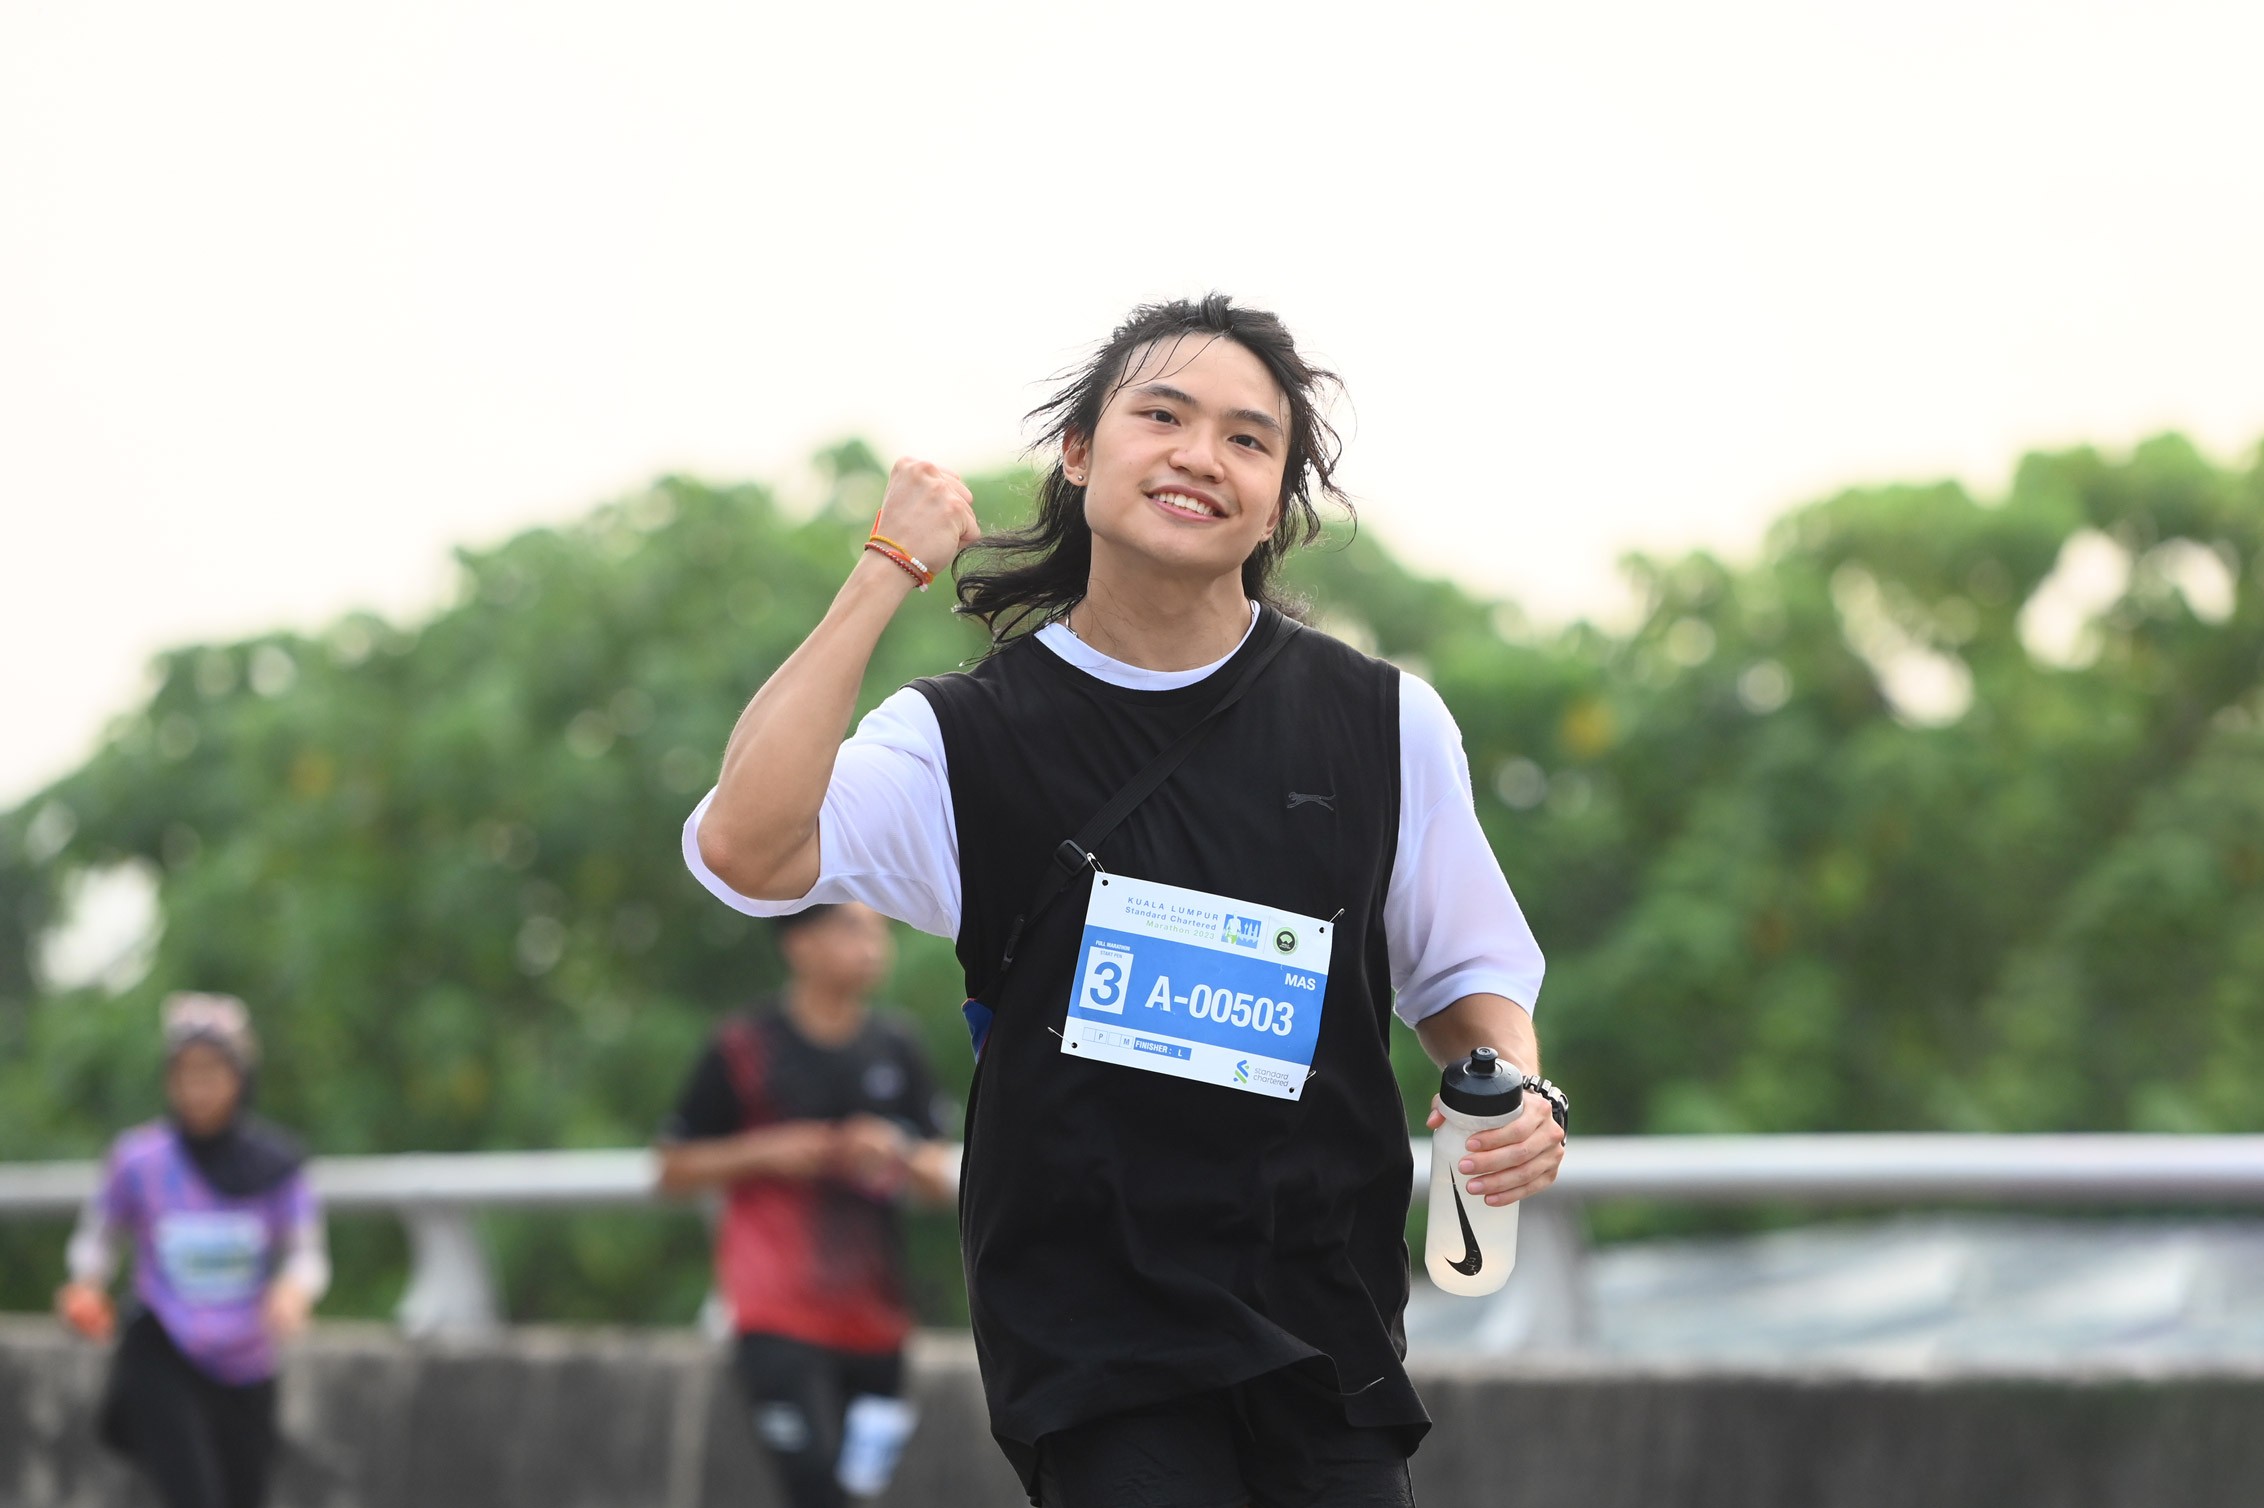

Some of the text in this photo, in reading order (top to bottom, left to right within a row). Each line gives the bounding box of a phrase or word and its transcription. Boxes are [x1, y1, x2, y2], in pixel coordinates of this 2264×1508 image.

[1125, 906, 1217, 931] Standard Chartered
[1127, 896, 1219, 921] KUALA LUMPUR
[1146, 920, 1215, 940] Marathon 2023
[1090, 961, 1122, 1006] 3
[1284, 972, 1317, 991] MAS
[1144, 975, 1295, 1036] A-00503
[1177, 1049, 1183, 1057] L
[1252, 1074, 1289, 1087] chartered
[1254, 1067, 1289, 1080] standard
